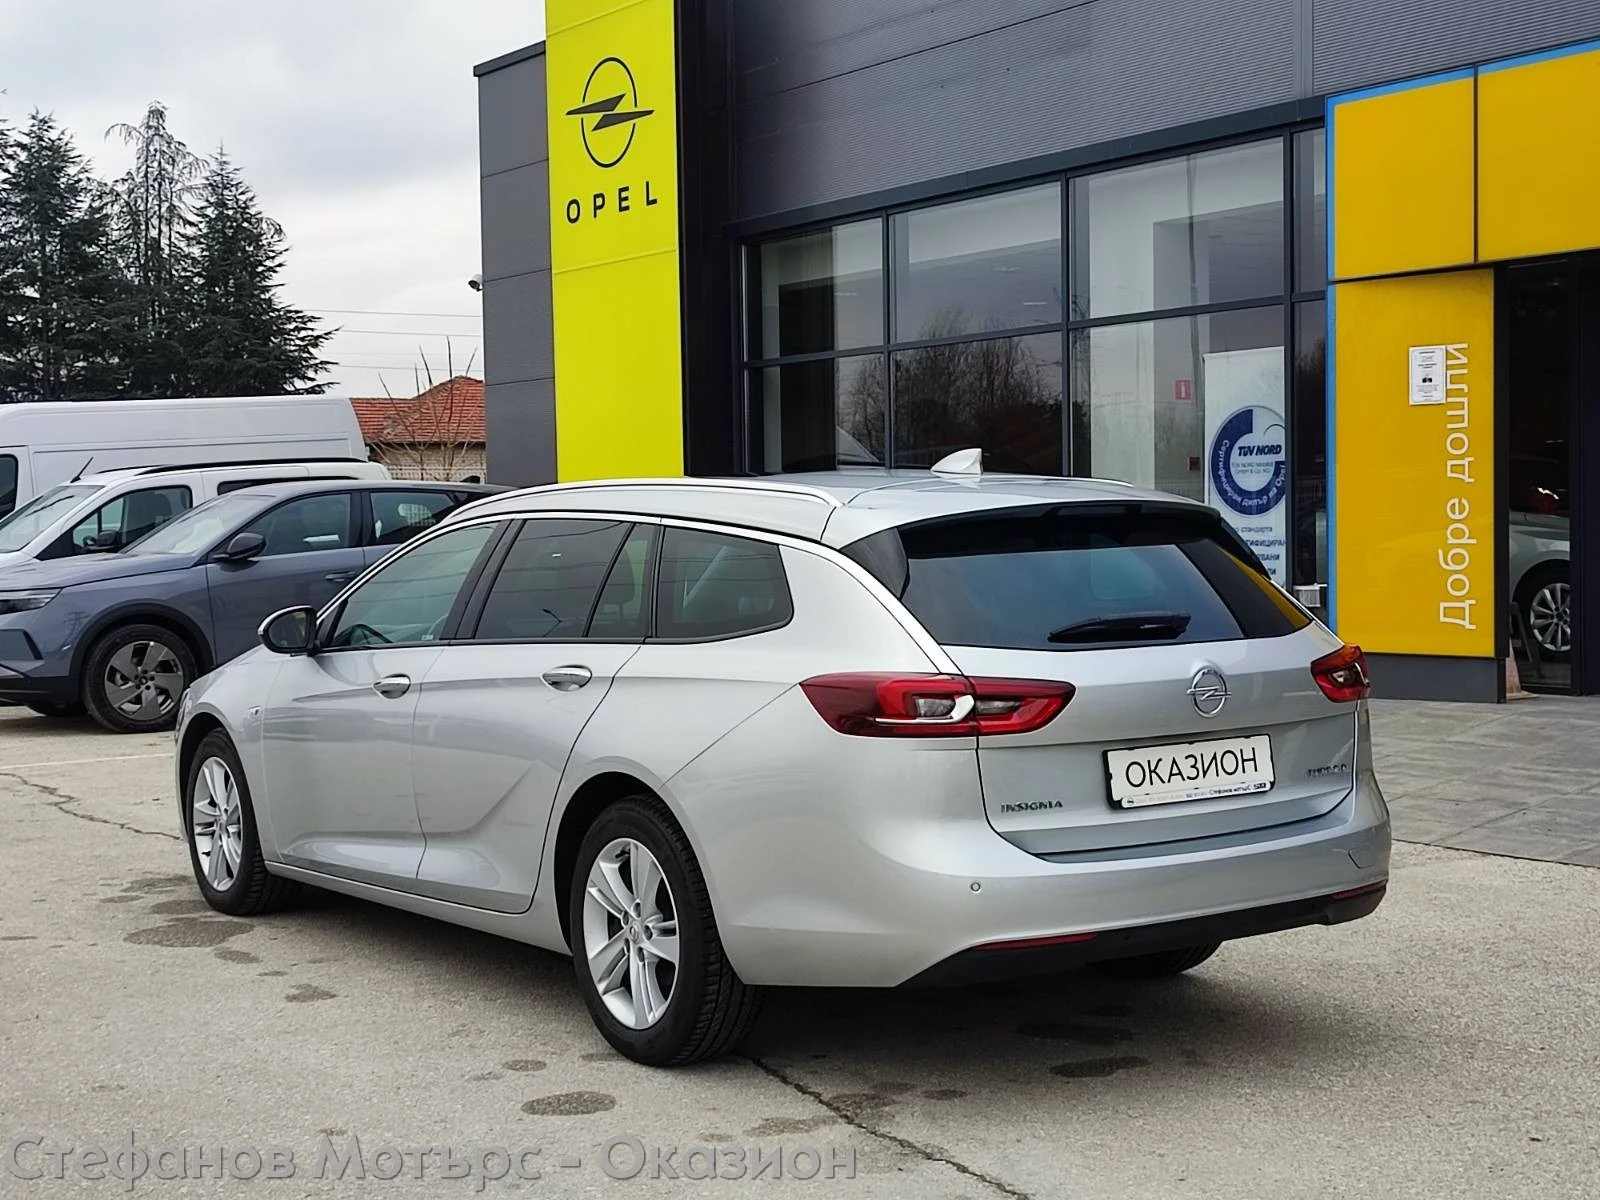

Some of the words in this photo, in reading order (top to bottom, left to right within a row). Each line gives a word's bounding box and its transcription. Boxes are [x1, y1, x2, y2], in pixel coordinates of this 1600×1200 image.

[566, 181, 658, 224] OPEL
[1445, 343, 1475, 483] дошли
[1255, 444, 1282, 456] NORD
[1438, 497, 1477, 630] Добре
[1125, 747, 1258, 787] ОКАЗИОН
[1001, 800, 1063, 813] INSIGNIA
